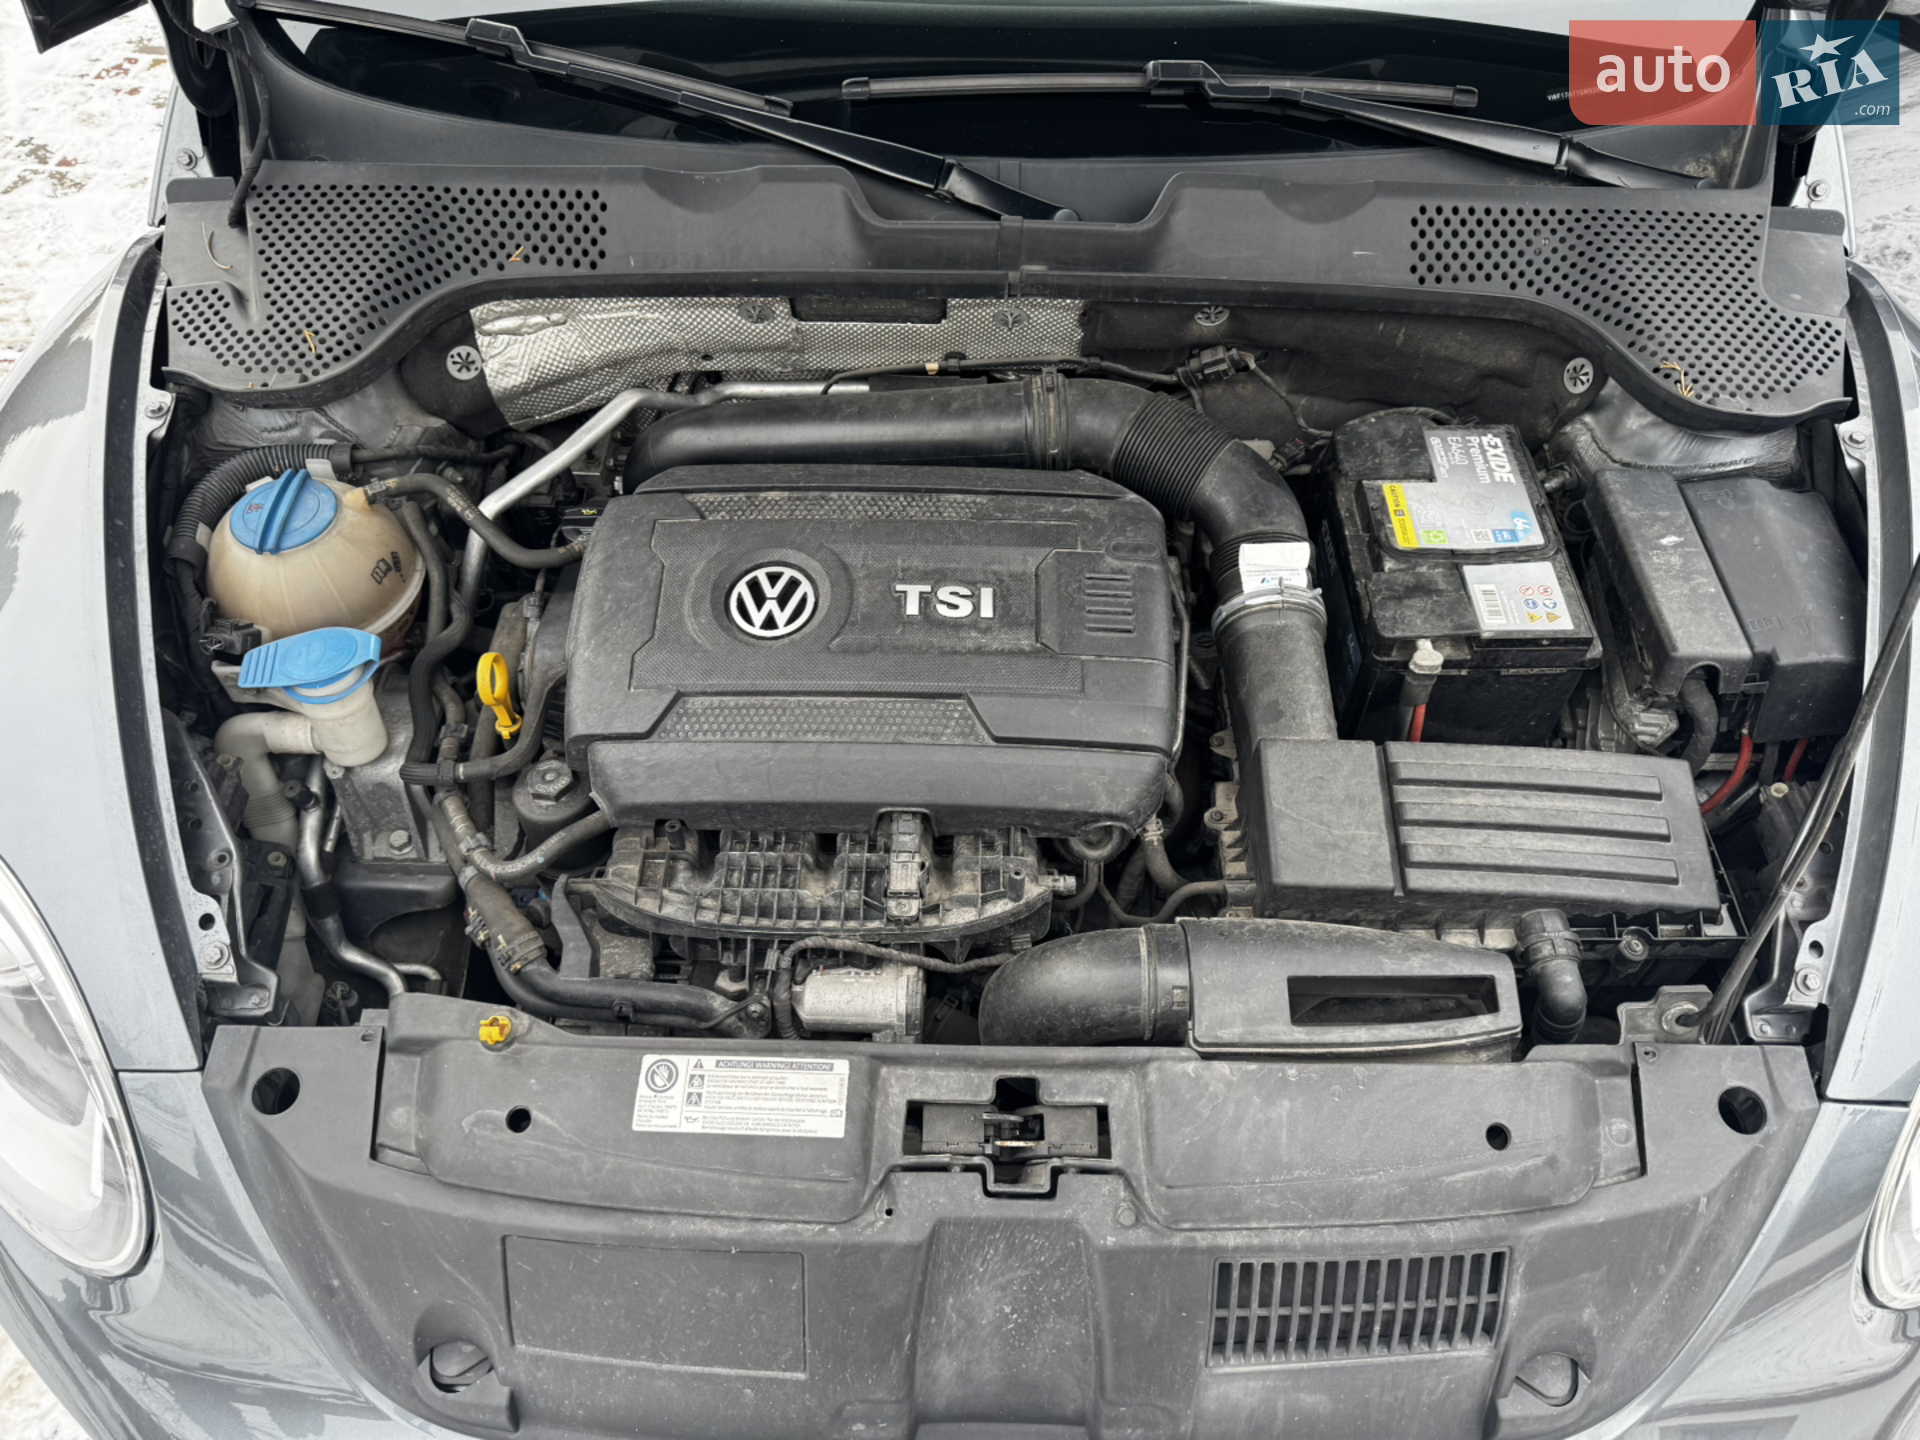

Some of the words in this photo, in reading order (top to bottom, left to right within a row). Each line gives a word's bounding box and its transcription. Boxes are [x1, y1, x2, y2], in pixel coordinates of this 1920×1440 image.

[1447, 436, 1469, 465] EA640
[1465, 436, 1491, 484] Premium
[1481, 433, 1517, 485] EXIDE
[895, 584, 994, 618] TSI
[718, 1061, 754, 1069] ACHTUNG!
[755, 1062, 790, 1070] WARNING!
[791, 1063, 830, 1071] ATTENTION!
